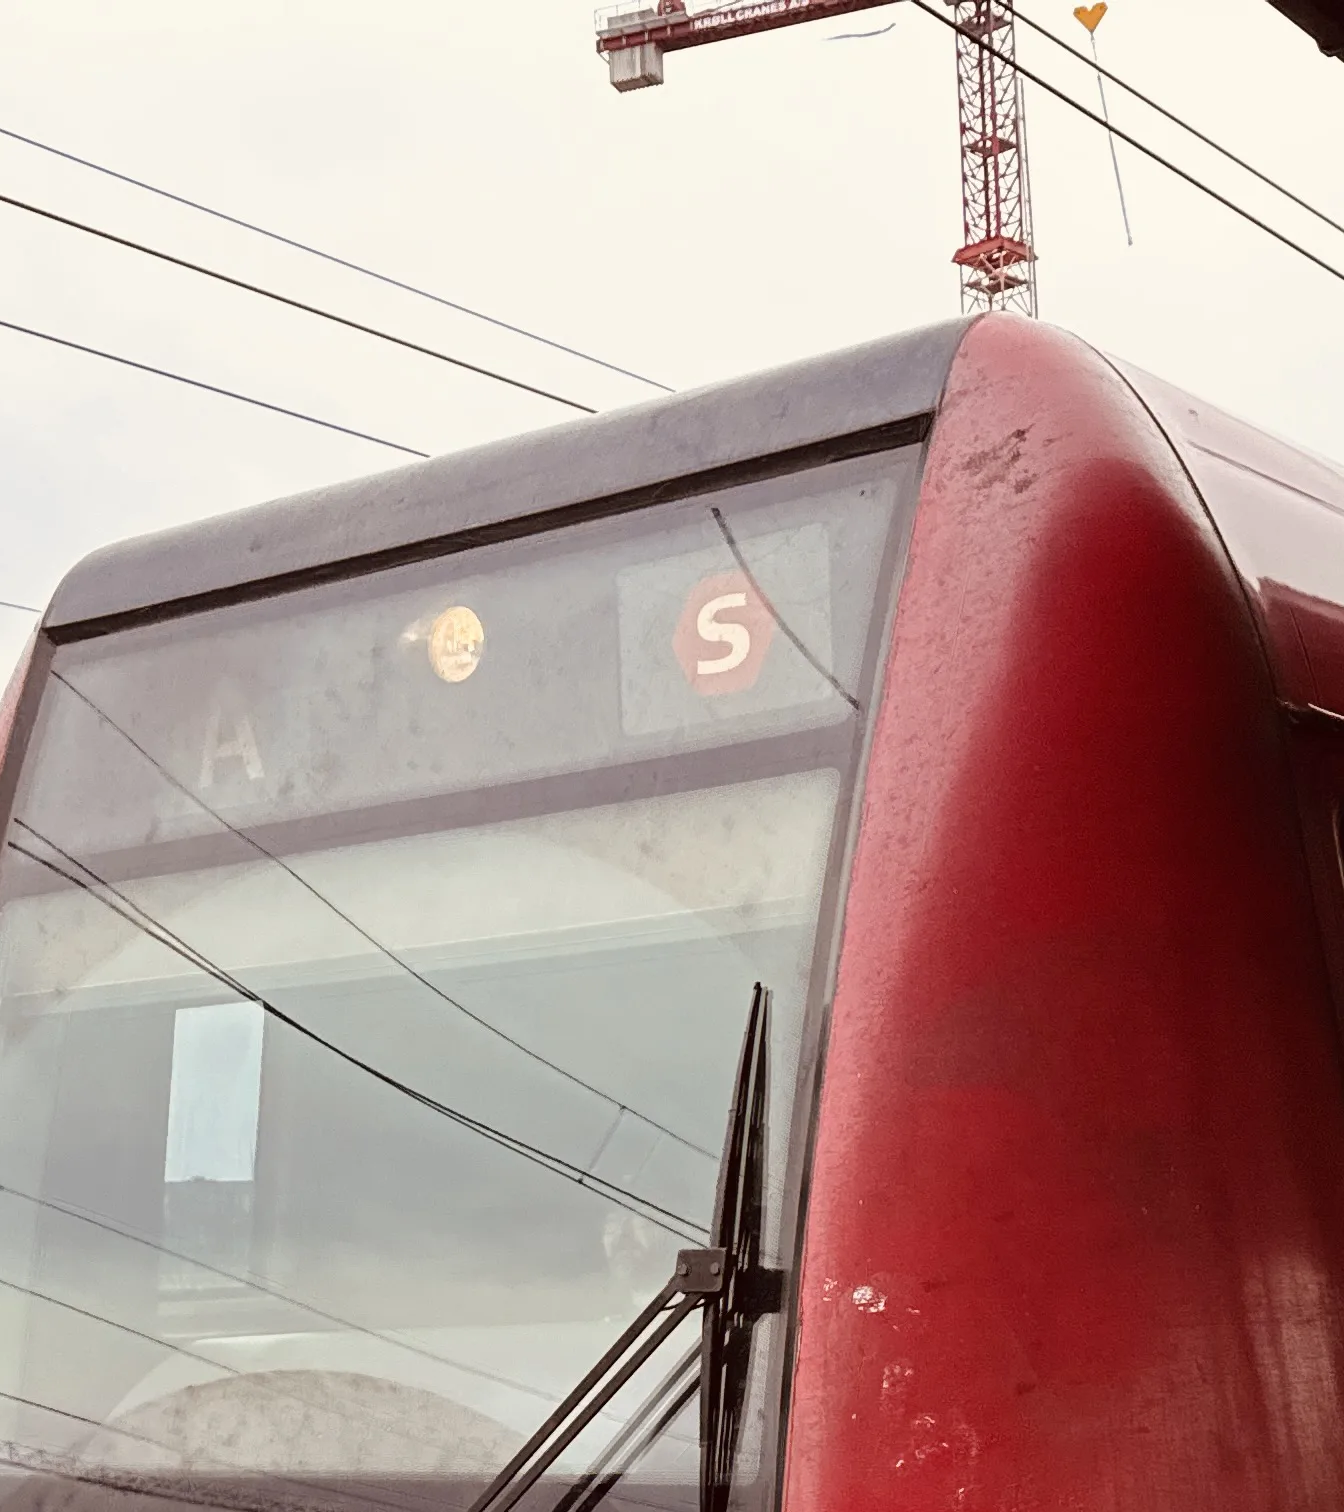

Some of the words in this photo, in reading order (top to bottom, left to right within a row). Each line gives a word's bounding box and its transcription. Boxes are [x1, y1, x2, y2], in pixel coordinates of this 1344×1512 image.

[736, 1, 786, 20] CRANES
[697, 592, 750, 675] S
[199, 678, 265, 788] A
